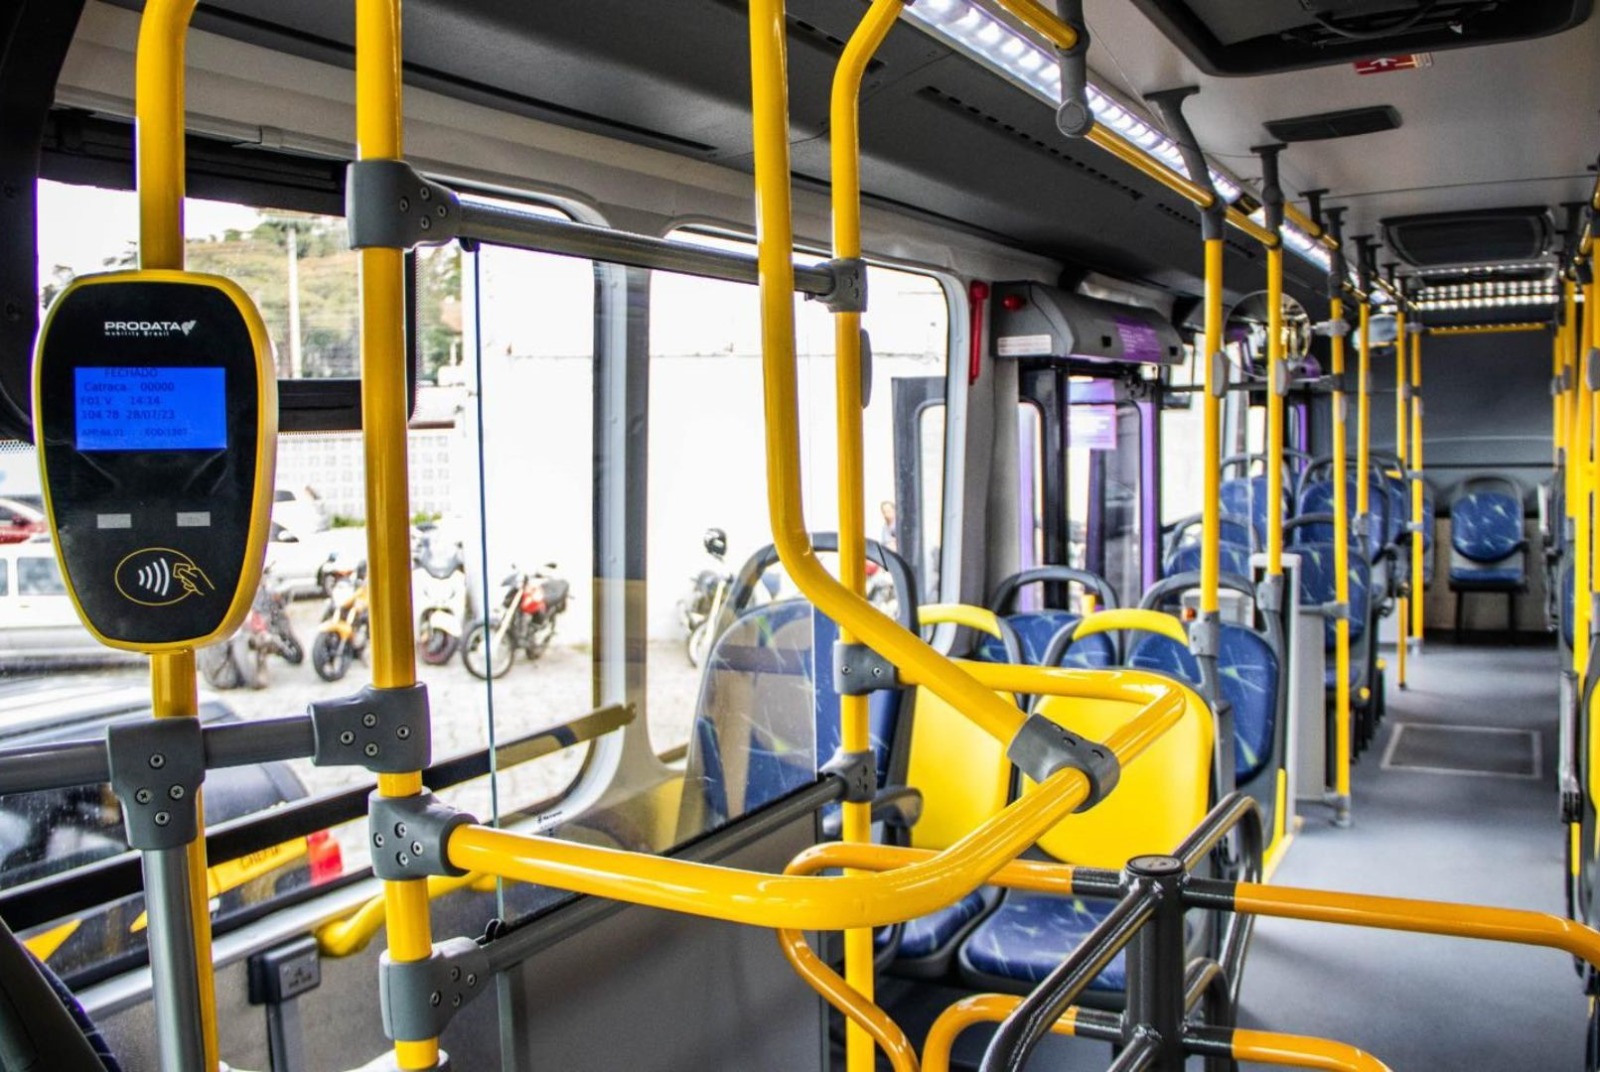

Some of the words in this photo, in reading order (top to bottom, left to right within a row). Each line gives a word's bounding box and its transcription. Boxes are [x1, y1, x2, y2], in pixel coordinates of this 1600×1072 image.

[104, 321, 181, 330] PRODATA
[104, 367, 158, 378] FECHADO
[139, 381, 175, 392] 00000
[130, 395, 161, 406] 14:14
[126, 410, 175, 420] 28/07/23
